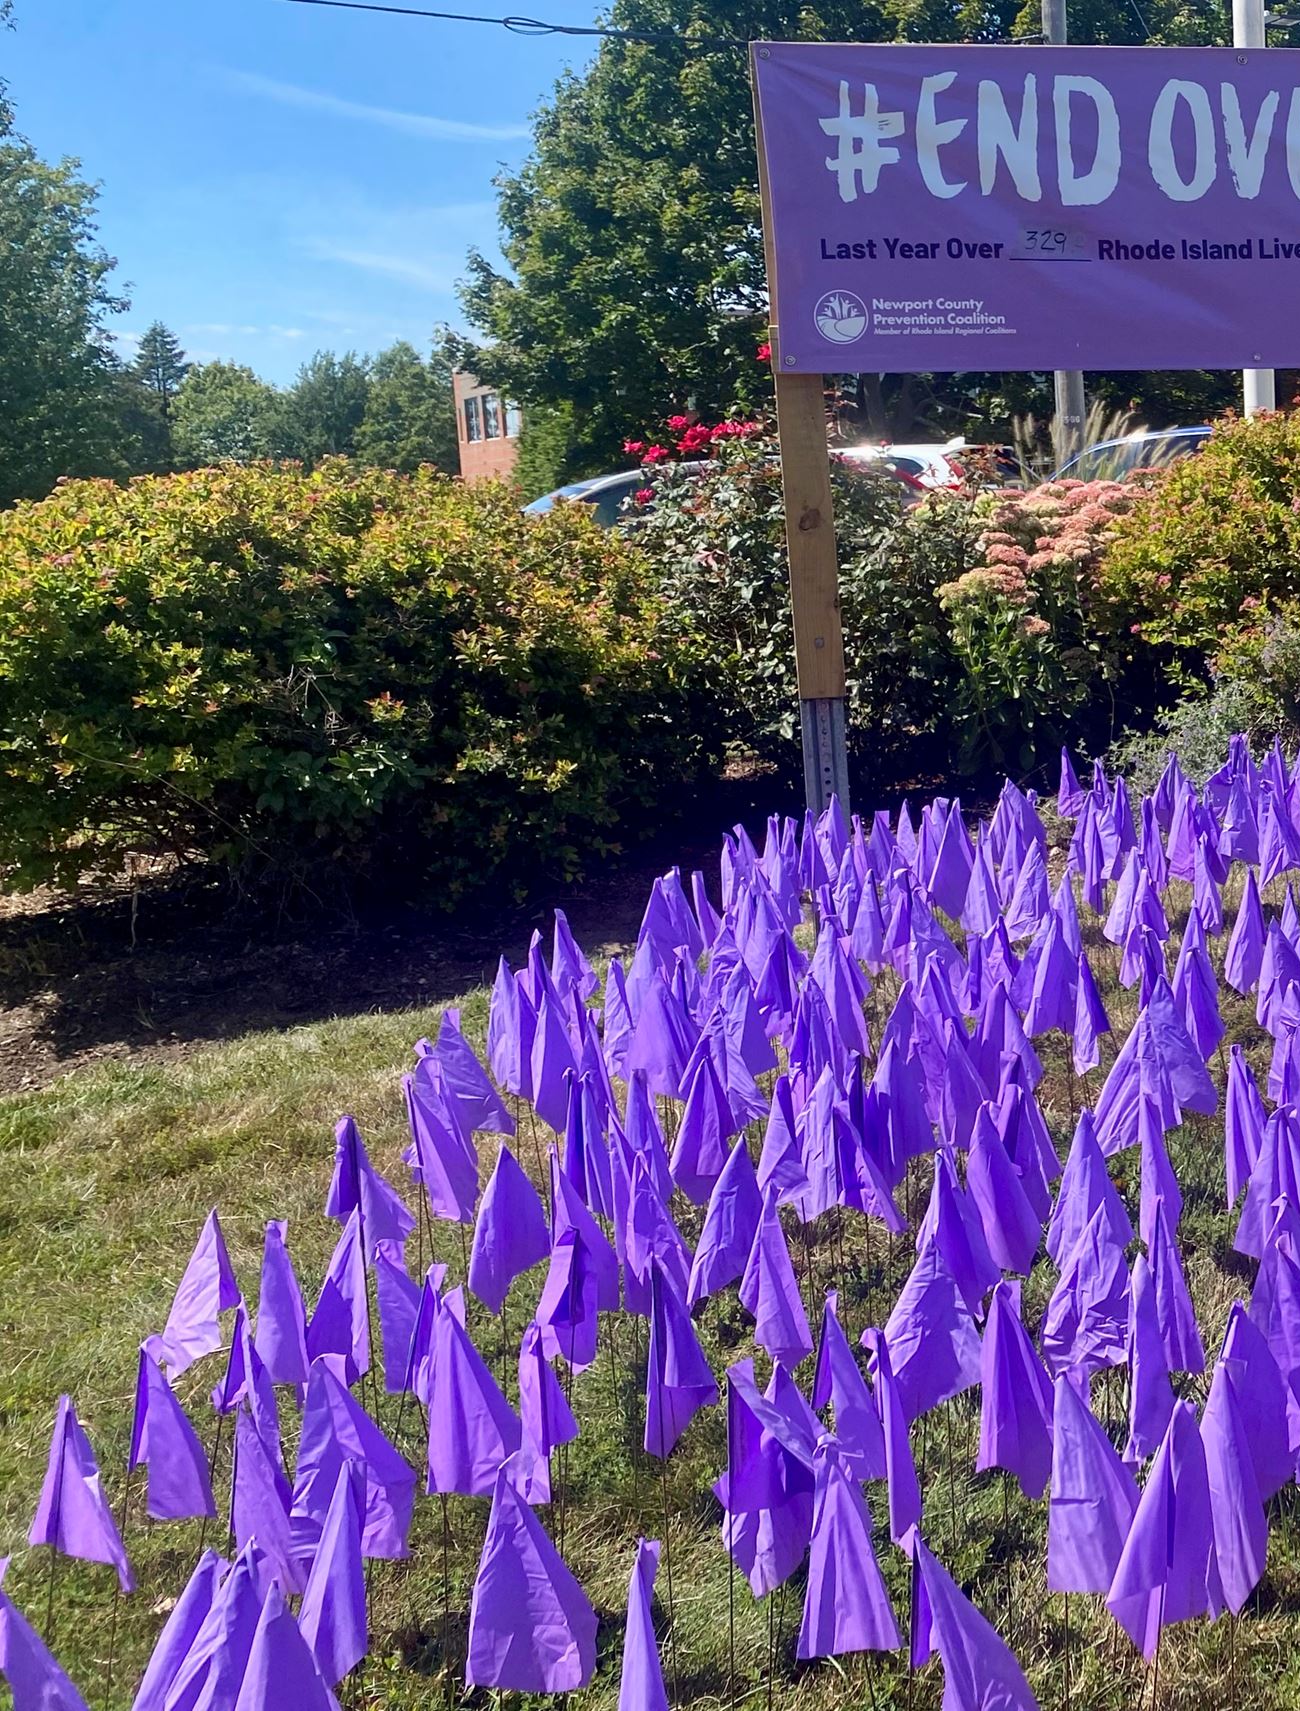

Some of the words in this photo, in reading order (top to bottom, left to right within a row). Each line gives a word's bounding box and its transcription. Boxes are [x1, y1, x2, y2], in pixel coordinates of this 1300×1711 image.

[819, 71, 1121, 206] #END
[820, 238, 877, 260] Last
[882, 237, 940, 259] Year
[946, 237, 1004, 259] Over
[1024, 231, 1067, 254] 329
[1098, 239, 1176, 260] Rhode
[1182, 238, 1252, 260] Island
[872, 298, 934, 313] Newport
[936, 297, 984, 313] County
[873, 313, 945, 325] Prevention
[947, 312, 1006, 325] Coalition
[874, 327, 901, 335] Member
[902, 327, 910, 335] of
[911, 327, 933, 335] Rhode
[933, 327, 954, 335] Island
[955, 327, 984, 336] Regional
[985, 326, 1017, 335] Coalitions
